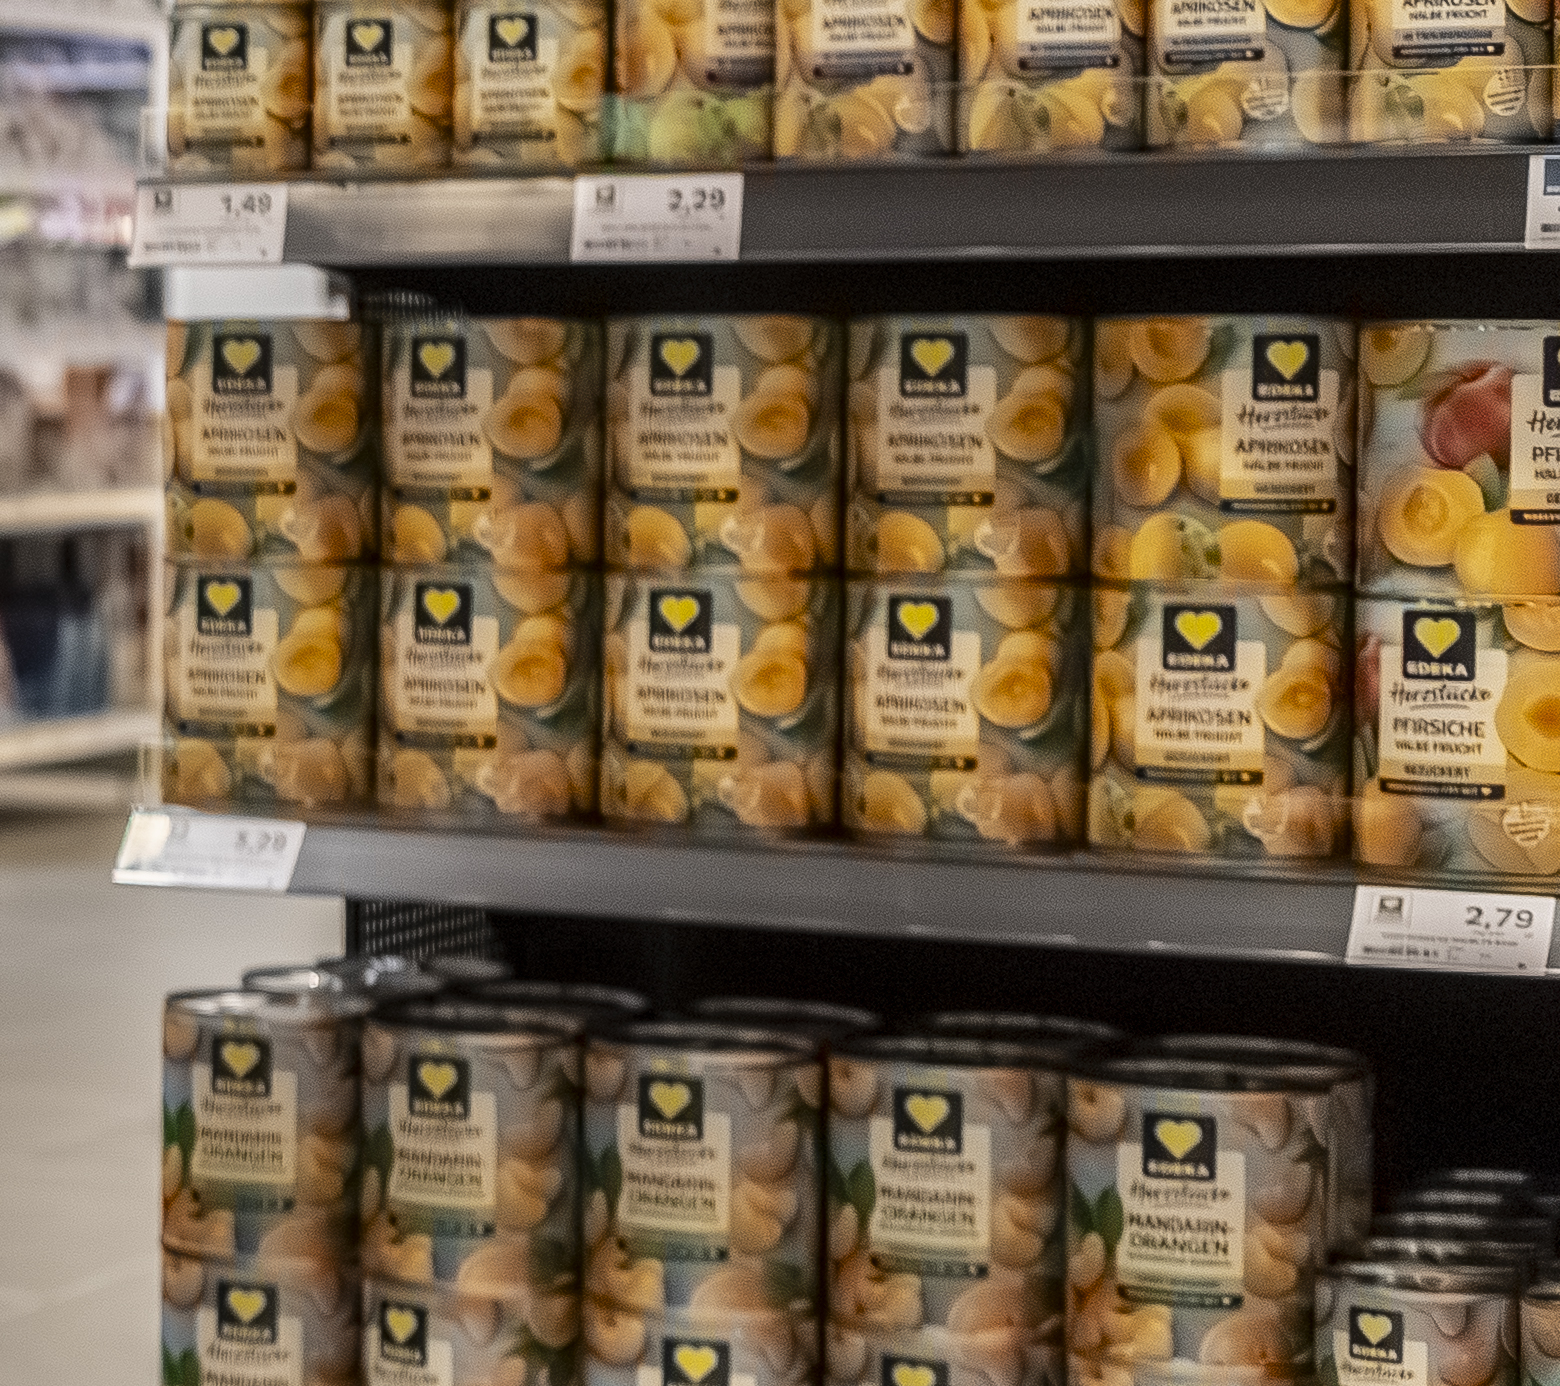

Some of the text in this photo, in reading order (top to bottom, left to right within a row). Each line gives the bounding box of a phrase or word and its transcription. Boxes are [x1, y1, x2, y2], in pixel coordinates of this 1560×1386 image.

[220, 192, 272, 216] 1,49
[666, 187, 726, 212] 2,29
[1406, 660, 1469, 678] EDEKA
[1465, 905, 1535, 930] 2,79
